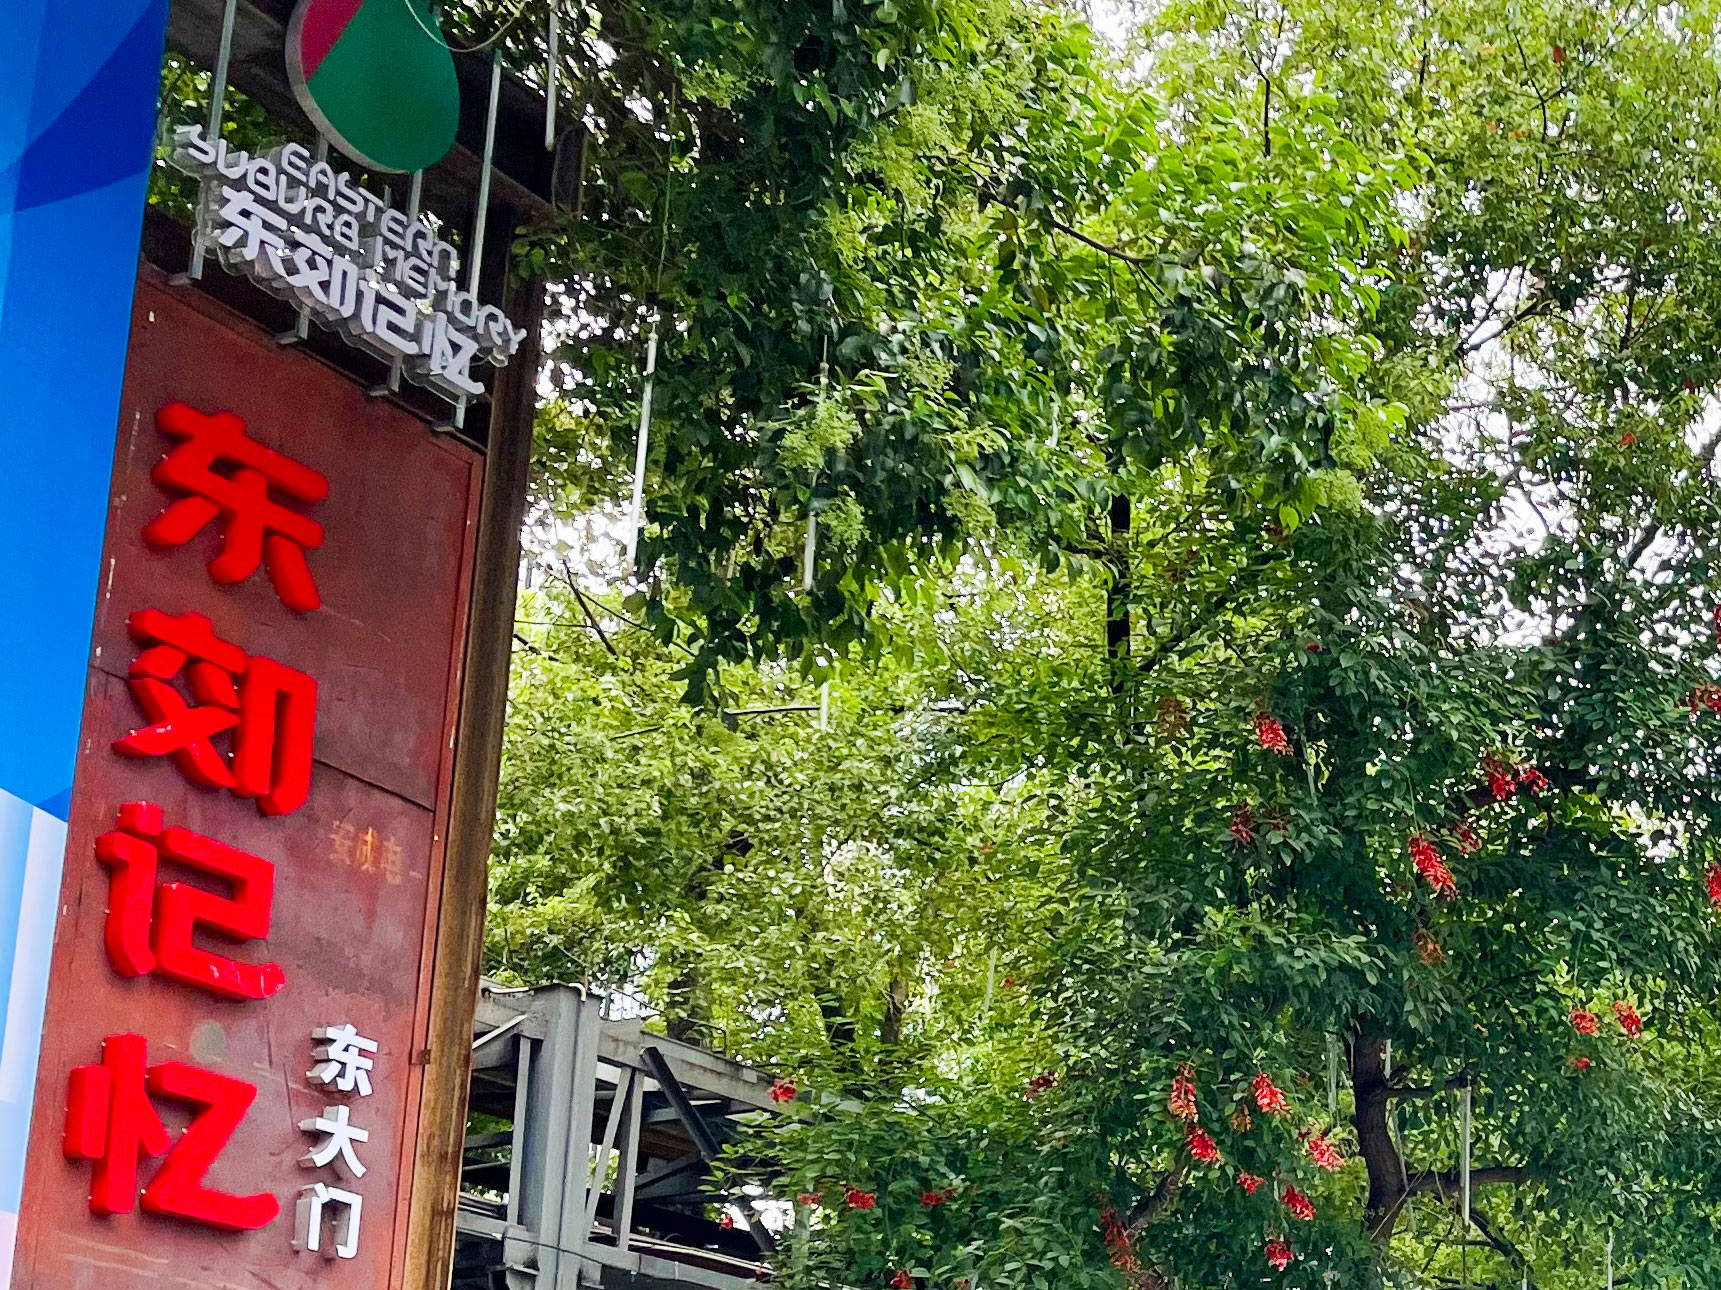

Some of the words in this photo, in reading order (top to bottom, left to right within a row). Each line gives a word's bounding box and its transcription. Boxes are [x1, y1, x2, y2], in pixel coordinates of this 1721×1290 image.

[219, 185, 486, 395] 东郊记忆
[281, 142, 458, 282] EASTERN
[374, 236, 528, 354] MEMORY
[62, 403, 329, 1232] 东郊记忆
[296, 1022, 380, 1261] 东大门
